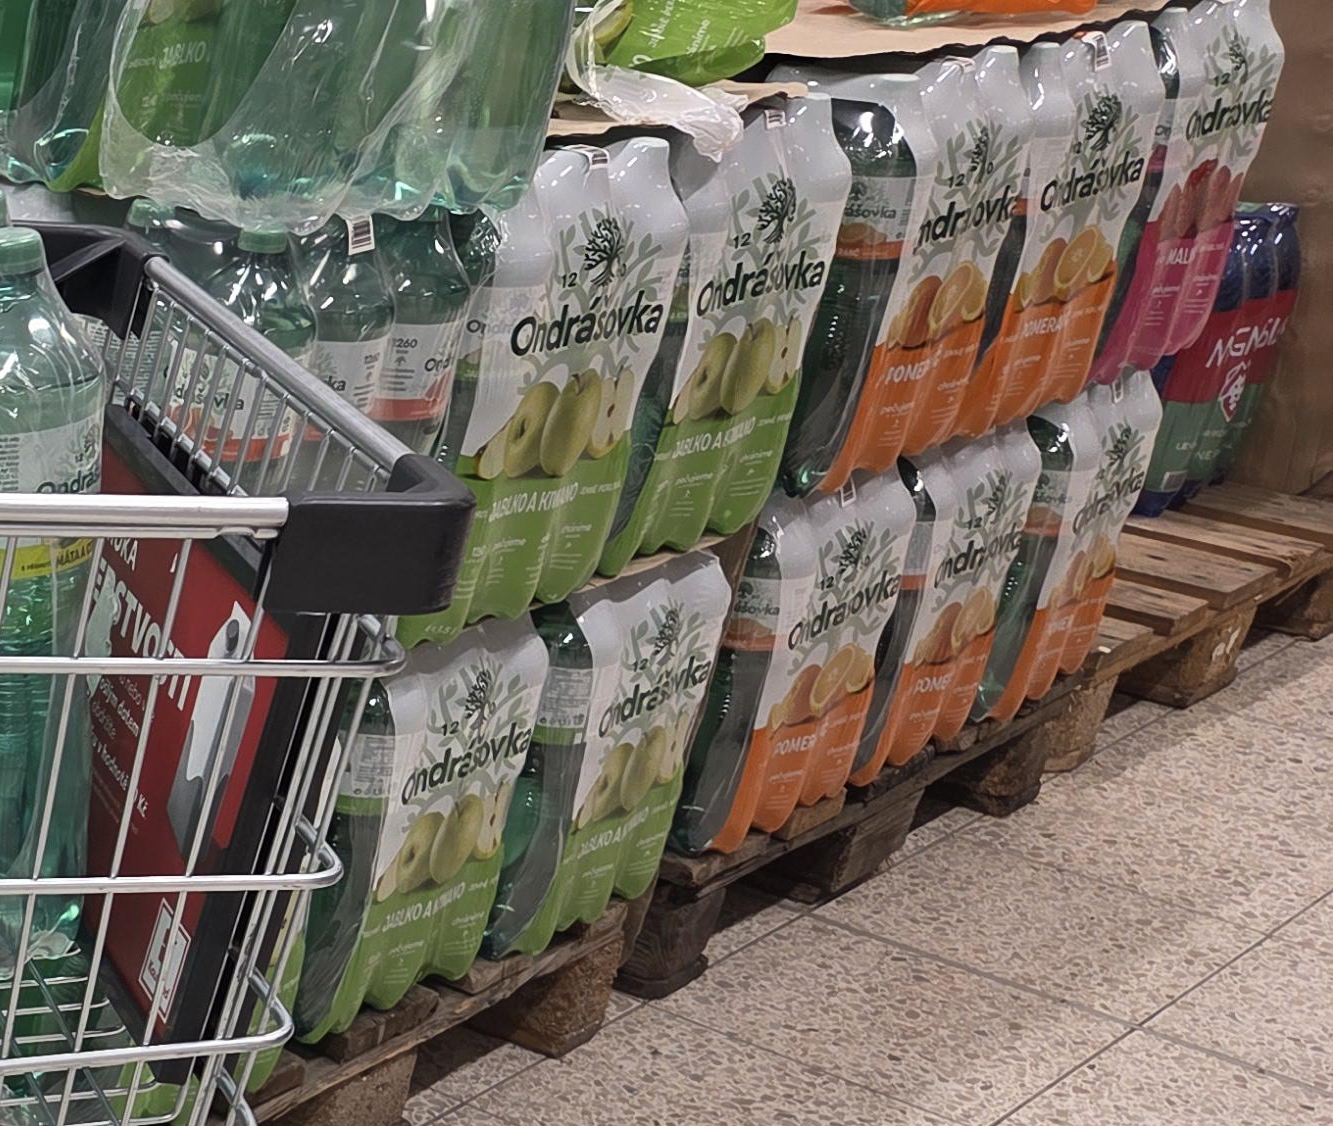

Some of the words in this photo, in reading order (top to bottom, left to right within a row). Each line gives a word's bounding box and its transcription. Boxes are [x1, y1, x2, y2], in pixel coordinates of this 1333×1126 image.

[733, 232, 751, 249] 12
[561, 272, 578, 288] 12
[441, 721, 460, 736] 12
